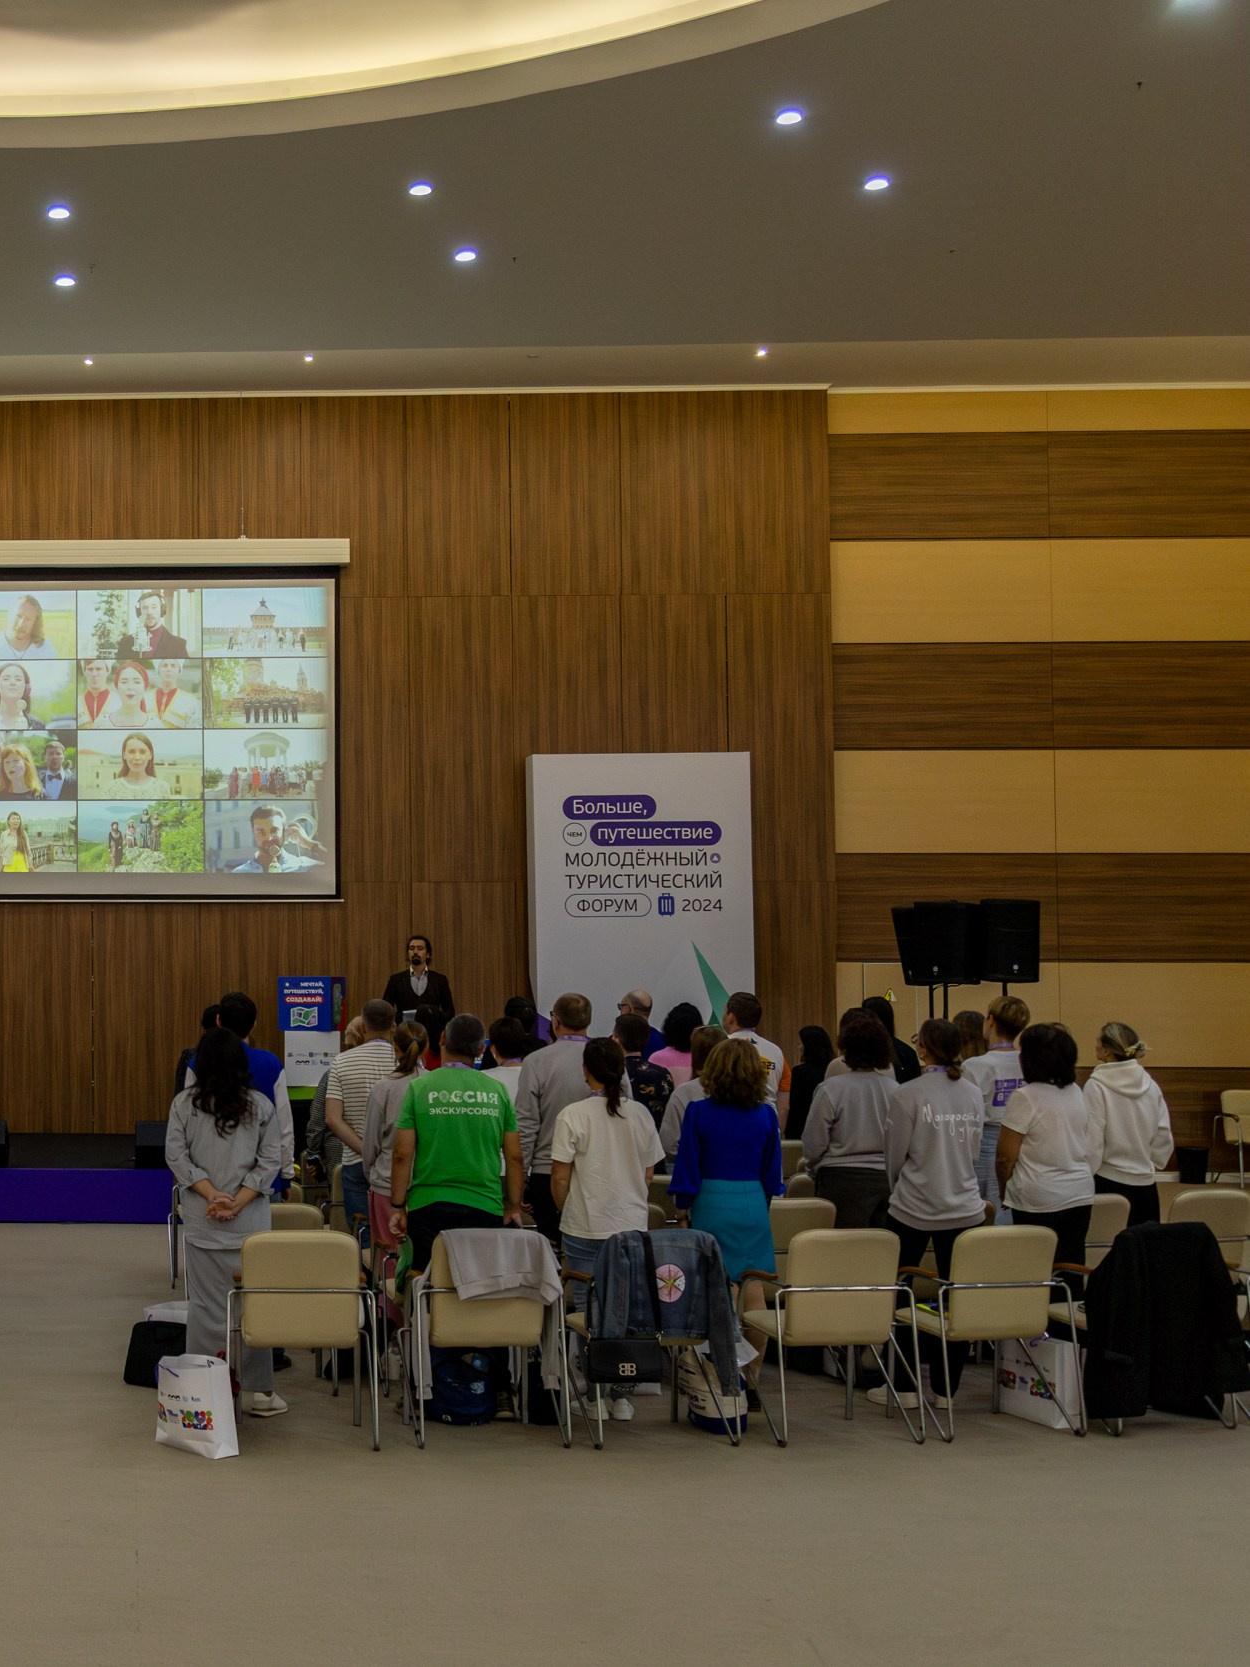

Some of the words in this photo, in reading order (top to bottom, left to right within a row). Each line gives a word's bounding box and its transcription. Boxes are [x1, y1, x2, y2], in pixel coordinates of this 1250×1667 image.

[572, 799, 648, 816] Больше,
[597, 826, 713, 843] путешествие
[565, 848, 707, 869] МОЛОДЁЖНЫЙ
[565, 870, 722, 889] ТУРИСТИЧЕСКИЙ
[577, 898, 638, 913] ФОРУМ
[682, 898, 723, 912] 2024
[428, 1090, 499, 1105] РОССИЯ
[429, 1106, 499, 1117] ЭКСКУРСОВОД
